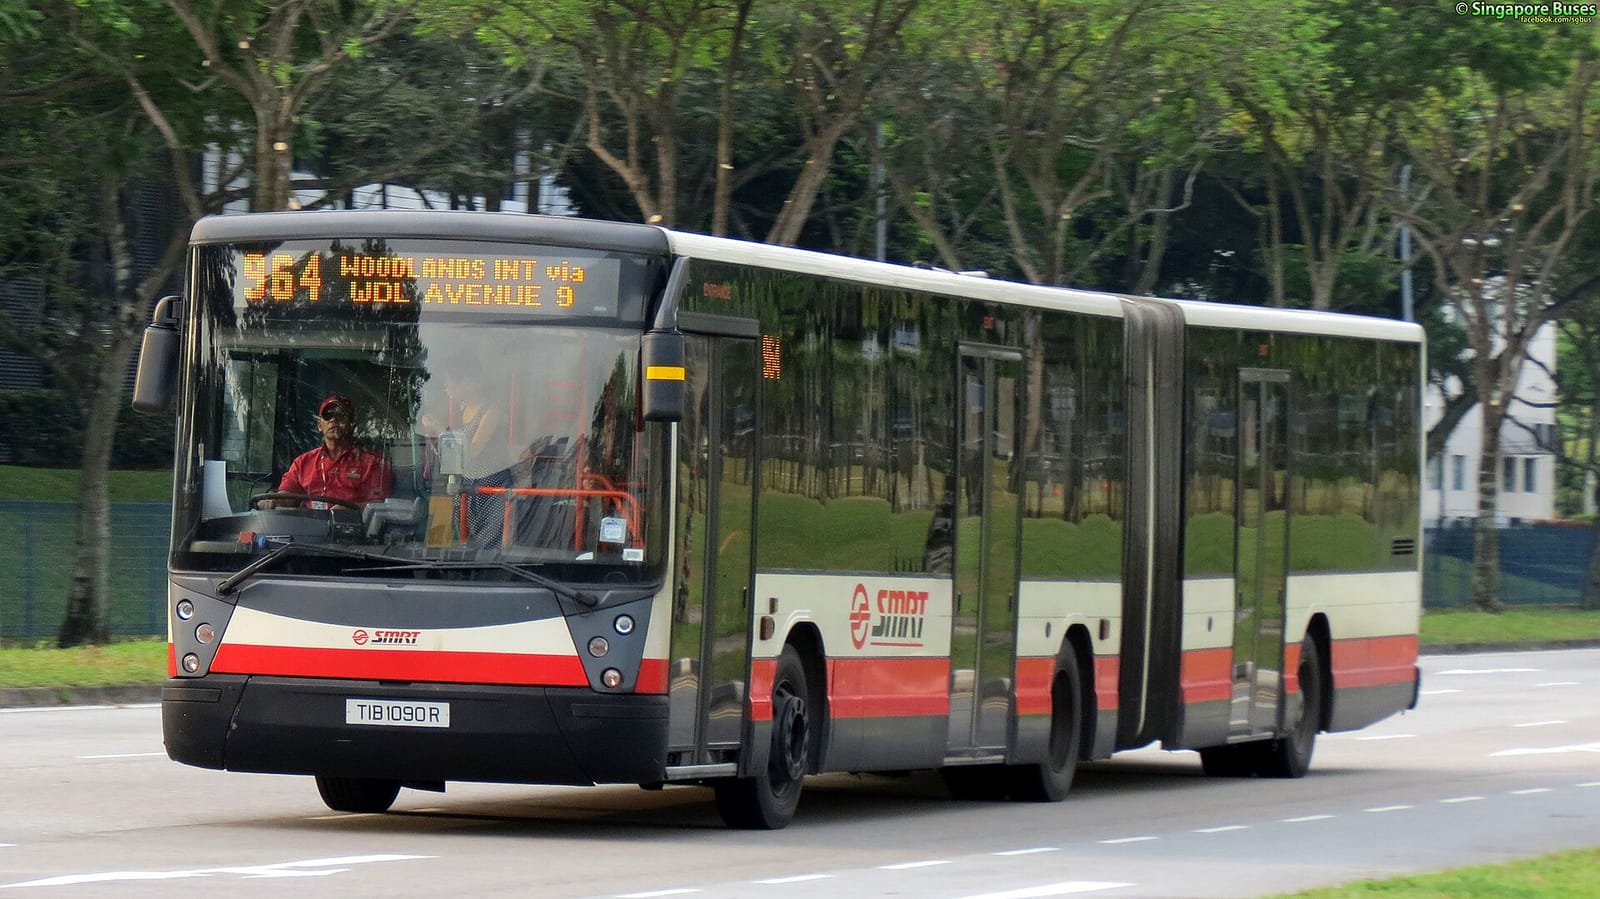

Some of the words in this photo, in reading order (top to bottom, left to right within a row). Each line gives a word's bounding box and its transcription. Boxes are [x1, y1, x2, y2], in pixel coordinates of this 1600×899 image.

[243, 253, 323, 301] 964
[340, 256, 485, 281] WOODLANDS
[494, 259, 537, 281] INT
[546, 261, 585, 283] via
[351, 281, 410, 303] WDL
[424, 283, 542, 307] AVENUE
[556, 285, 575, 308] 9
[871, 589, 929, 639] SMRT
[371, 630, 421, 644] SMRT
